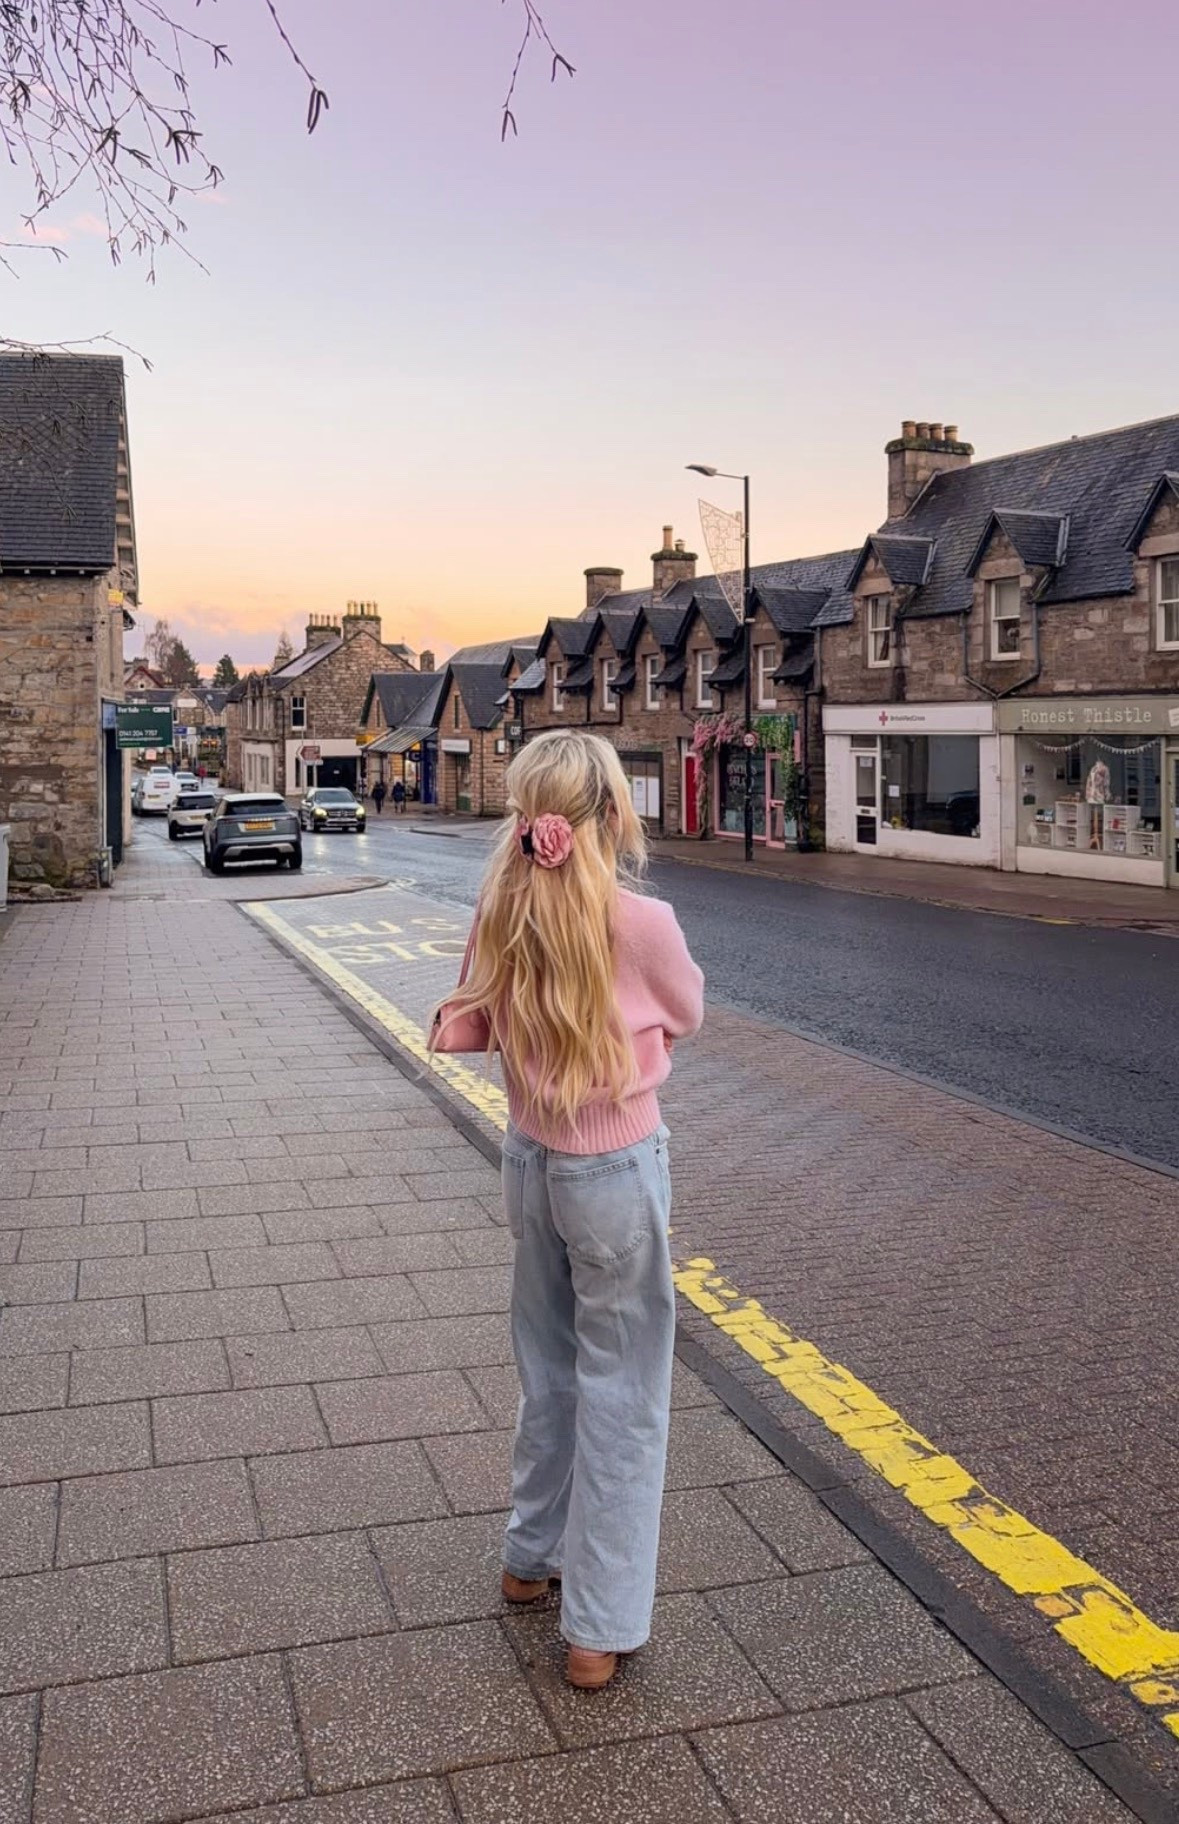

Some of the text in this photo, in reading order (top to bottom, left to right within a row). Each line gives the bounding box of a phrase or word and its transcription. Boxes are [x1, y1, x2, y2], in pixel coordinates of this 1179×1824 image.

[1020, 708, 1075, 723] Honest
[1083, 707, 1152, 723] Thistle
[305, 917, 463, 938] BUS
